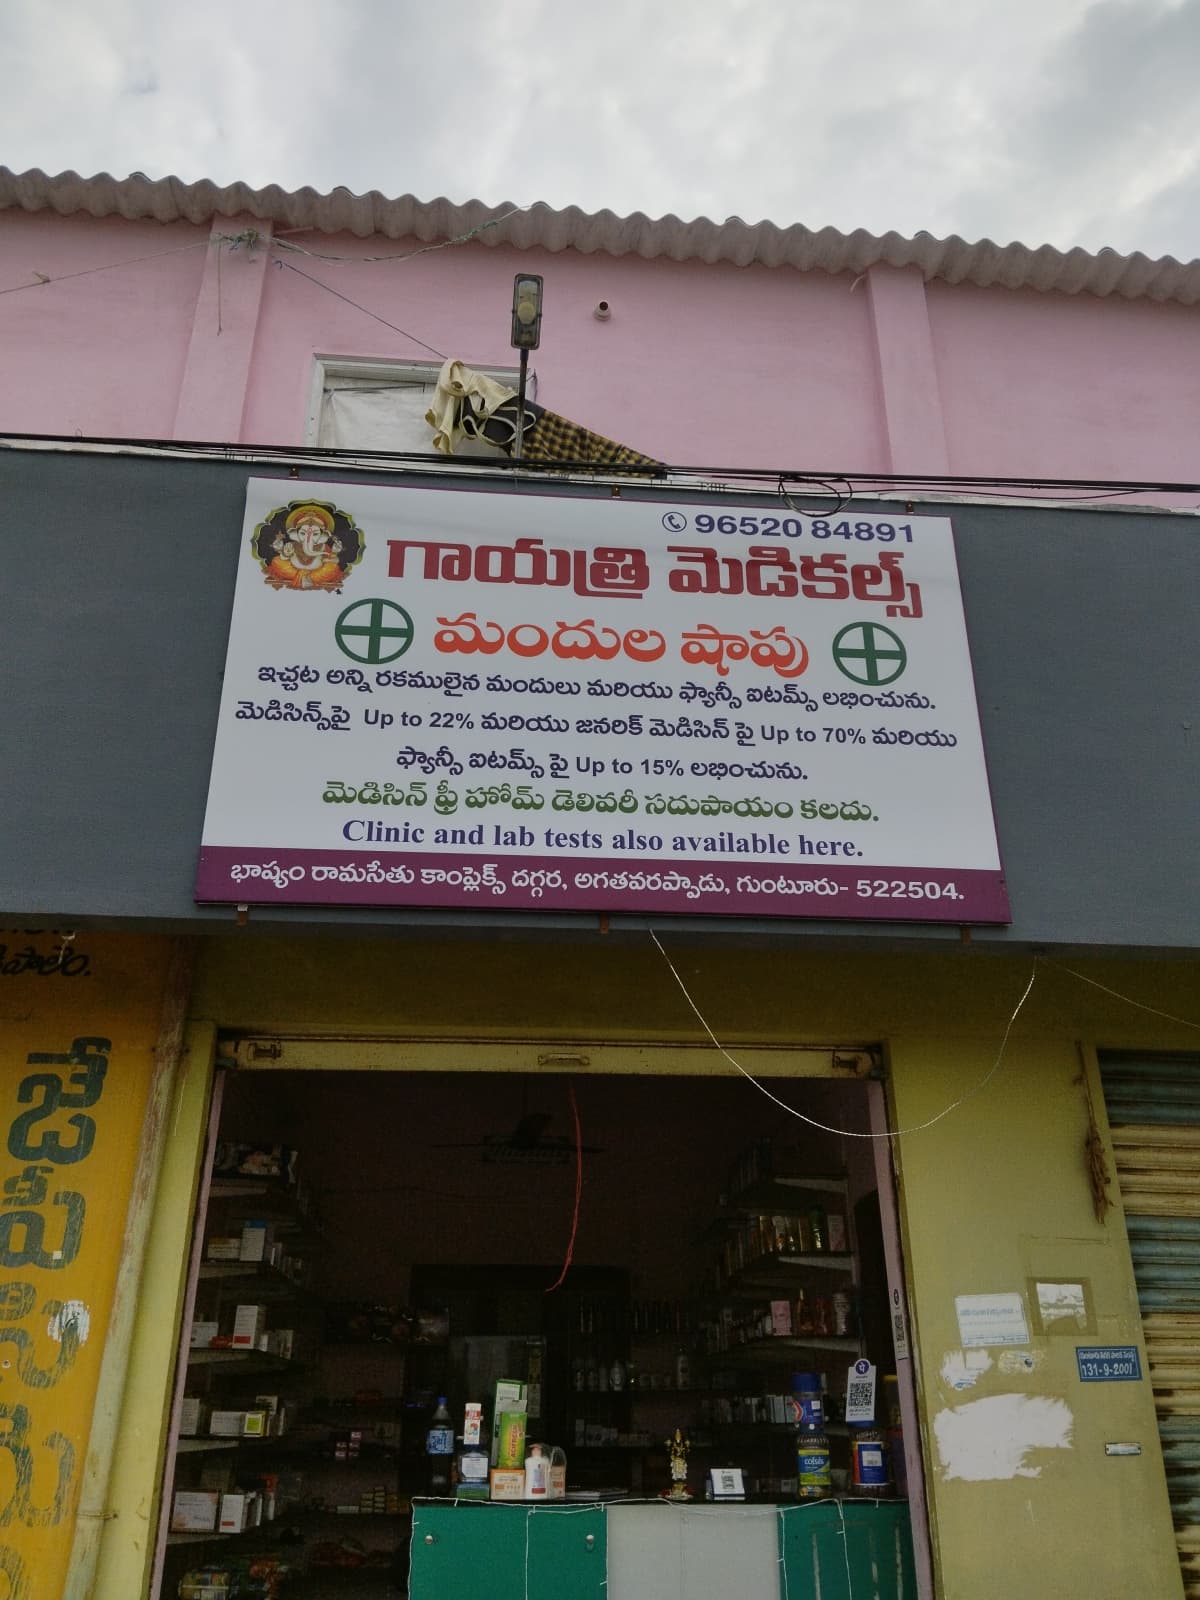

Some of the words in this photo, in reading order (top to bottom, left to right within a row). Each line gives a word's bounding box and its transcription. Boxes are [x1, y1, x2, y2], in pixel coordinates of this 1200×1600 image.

[695, 514, 802, 538] 96520
[811, 519, 913, 542] 84891
[387, 538, 650, 599] గాయత్రి
[667, 545, 923, 618] మెడికల్స్
[433, 612, 666, 662] మందుల
[680, 623, 809, 678] షాపు
[258, 665, 320, 691] ఇచ్చట
[326, 669, 373, 693] అన్ని
[375, 670, 480, 697] రకములైన
[486, 675, 581, 696] మందులు
[587, 679, 673, 699] మరియు
[746, 684, 819, 712] ఐటమ్స్
[364, 709, 394, 729] Up
[401, 711, 422, 727] to
[429, 712, 474, 729] 22%
[481, 713, 570, 733] మరియు
[575, 715, 643, 736] జనరిక్
[649, 717, 730, 739] మెడిసిన్
[735, 722, 756, 747] పై
[761, 725, 789, 745] Up
[796, 727, 816, 742] to
[822, 727, 866, 744] 70%
[872, 728, 957, 747] మరియు
[469, 748, 545, 779] ఐటమ్స్
[549, 752, 570, 779] పై
[576, 757, 604, 776] Up
[612, 758, 633, 774] to
[640, 759, 684, 777] 15%
[322, 780, 428, 807] మెడిసిన్
[433, 780, 458, 815] ఫ్రీ
[465, 783, 545, 811] హోమ్
[551, 788, 639, 814] డెలివరీ
[645, 793, 794, 818] సదుపాయం
[800, 798, 879, 822] కలదు.
[342, 820, 425, 843] Clinic
[433, 824, 484, 845] and
[494, 825, 535, 847] lab
[544, 827, 603, 849] tests
[612, 829, 663, 851] also
[672, 832, 790, 855] available
[799, 834, 863, 857] here.
[230, 860, 305, 889] భాష్యం
[311, 860, 415, 884] రామసేతు
[420, 863, 507, 895] కాంప్లెక్స్
[511, 868, 567, 898] దగ్గర,
[856, 879, 965, 900] 522504.
